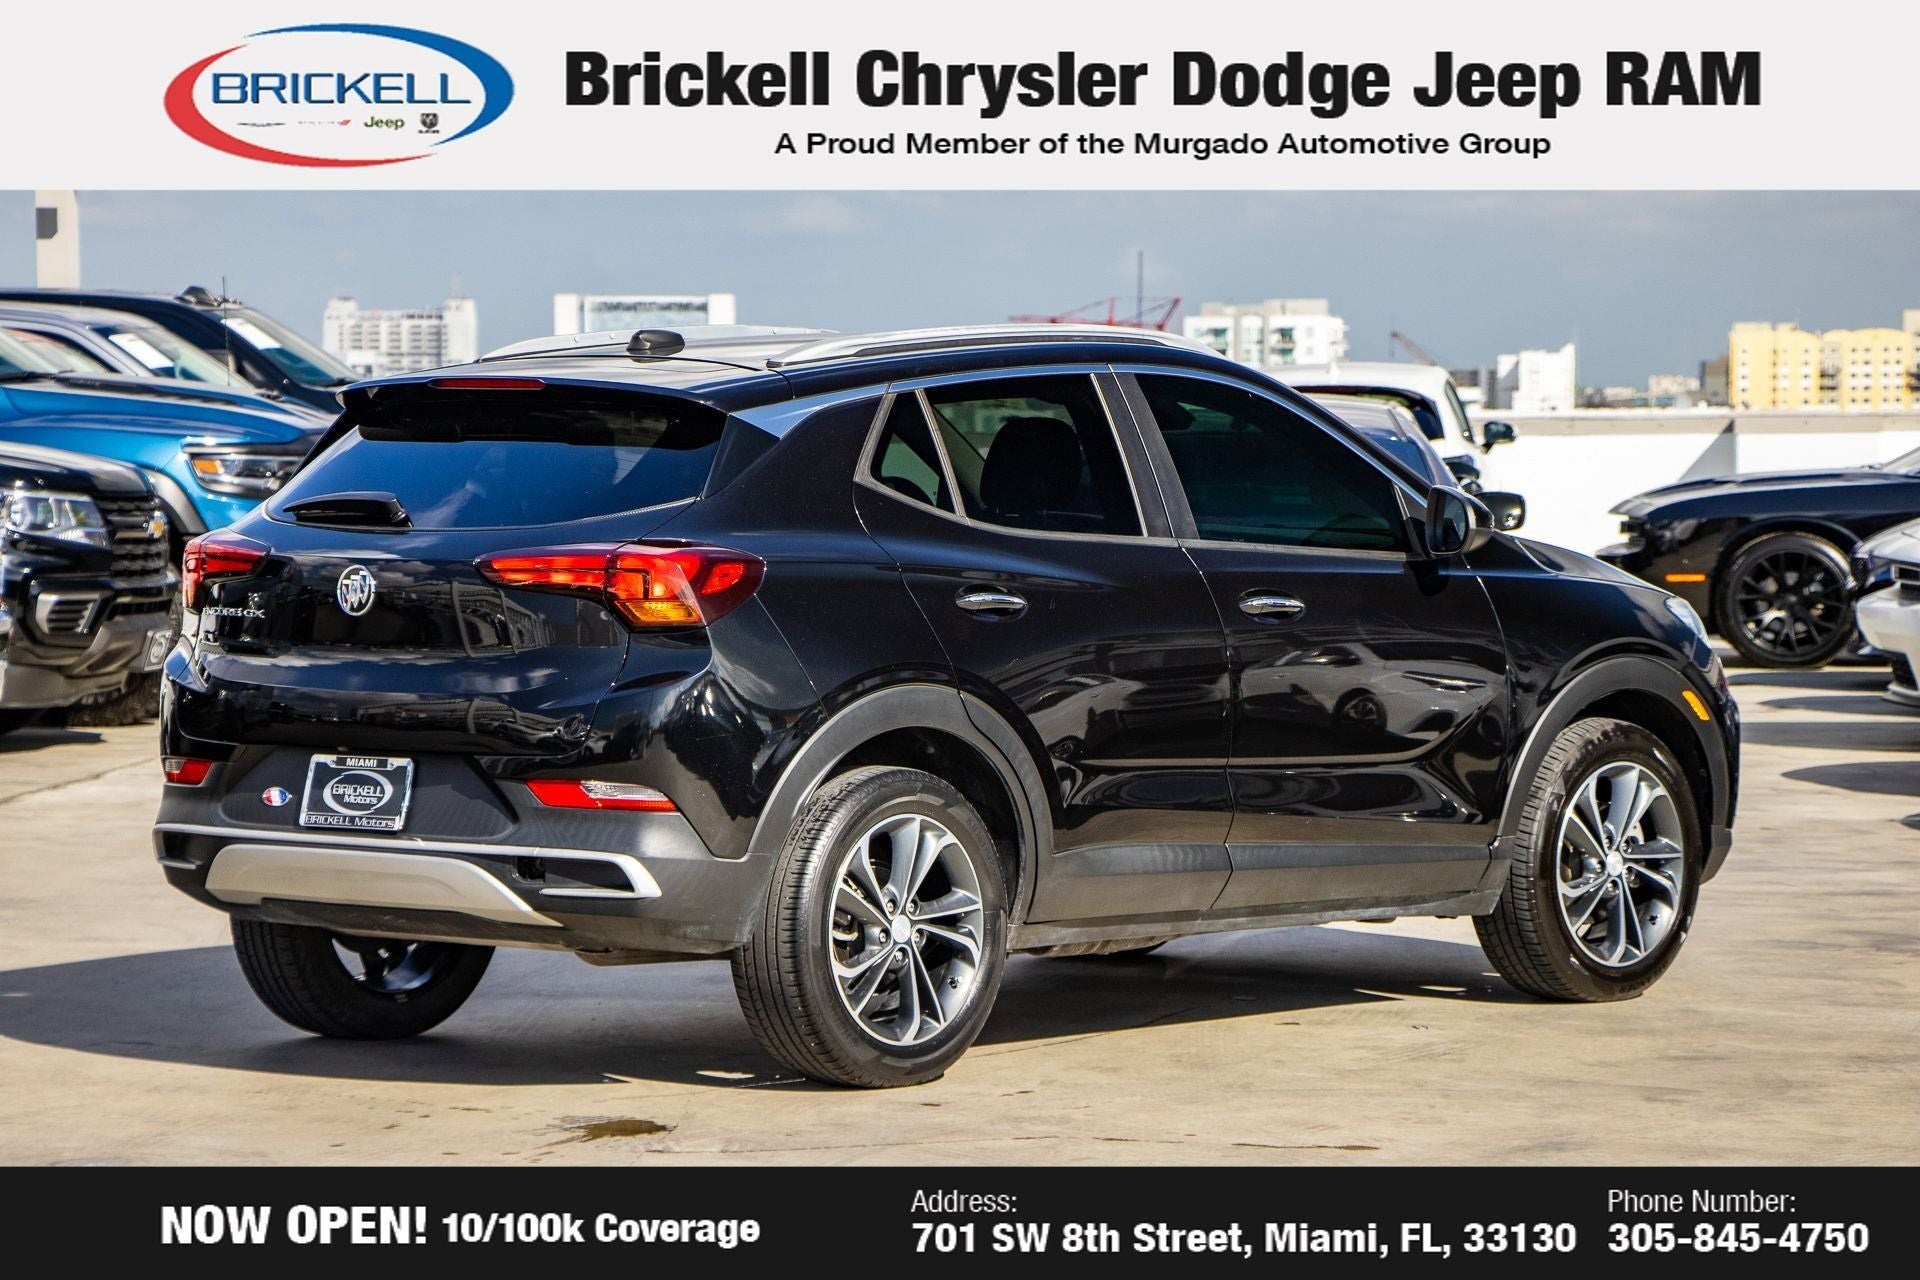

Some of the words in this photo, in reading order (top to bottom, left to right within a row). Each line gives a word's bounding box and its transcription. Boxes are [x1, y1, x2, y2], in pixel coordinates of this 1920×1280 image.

[243, 608, 266, 618] GX
[346, 757, 378, 768] MIAMI
[332, 783, 384, 797] BRICKELL
[343, 794, 378, 805] Motors
[305, 813, 352, 826] BRICKELL
[354, 816, 395, 828] Motors
